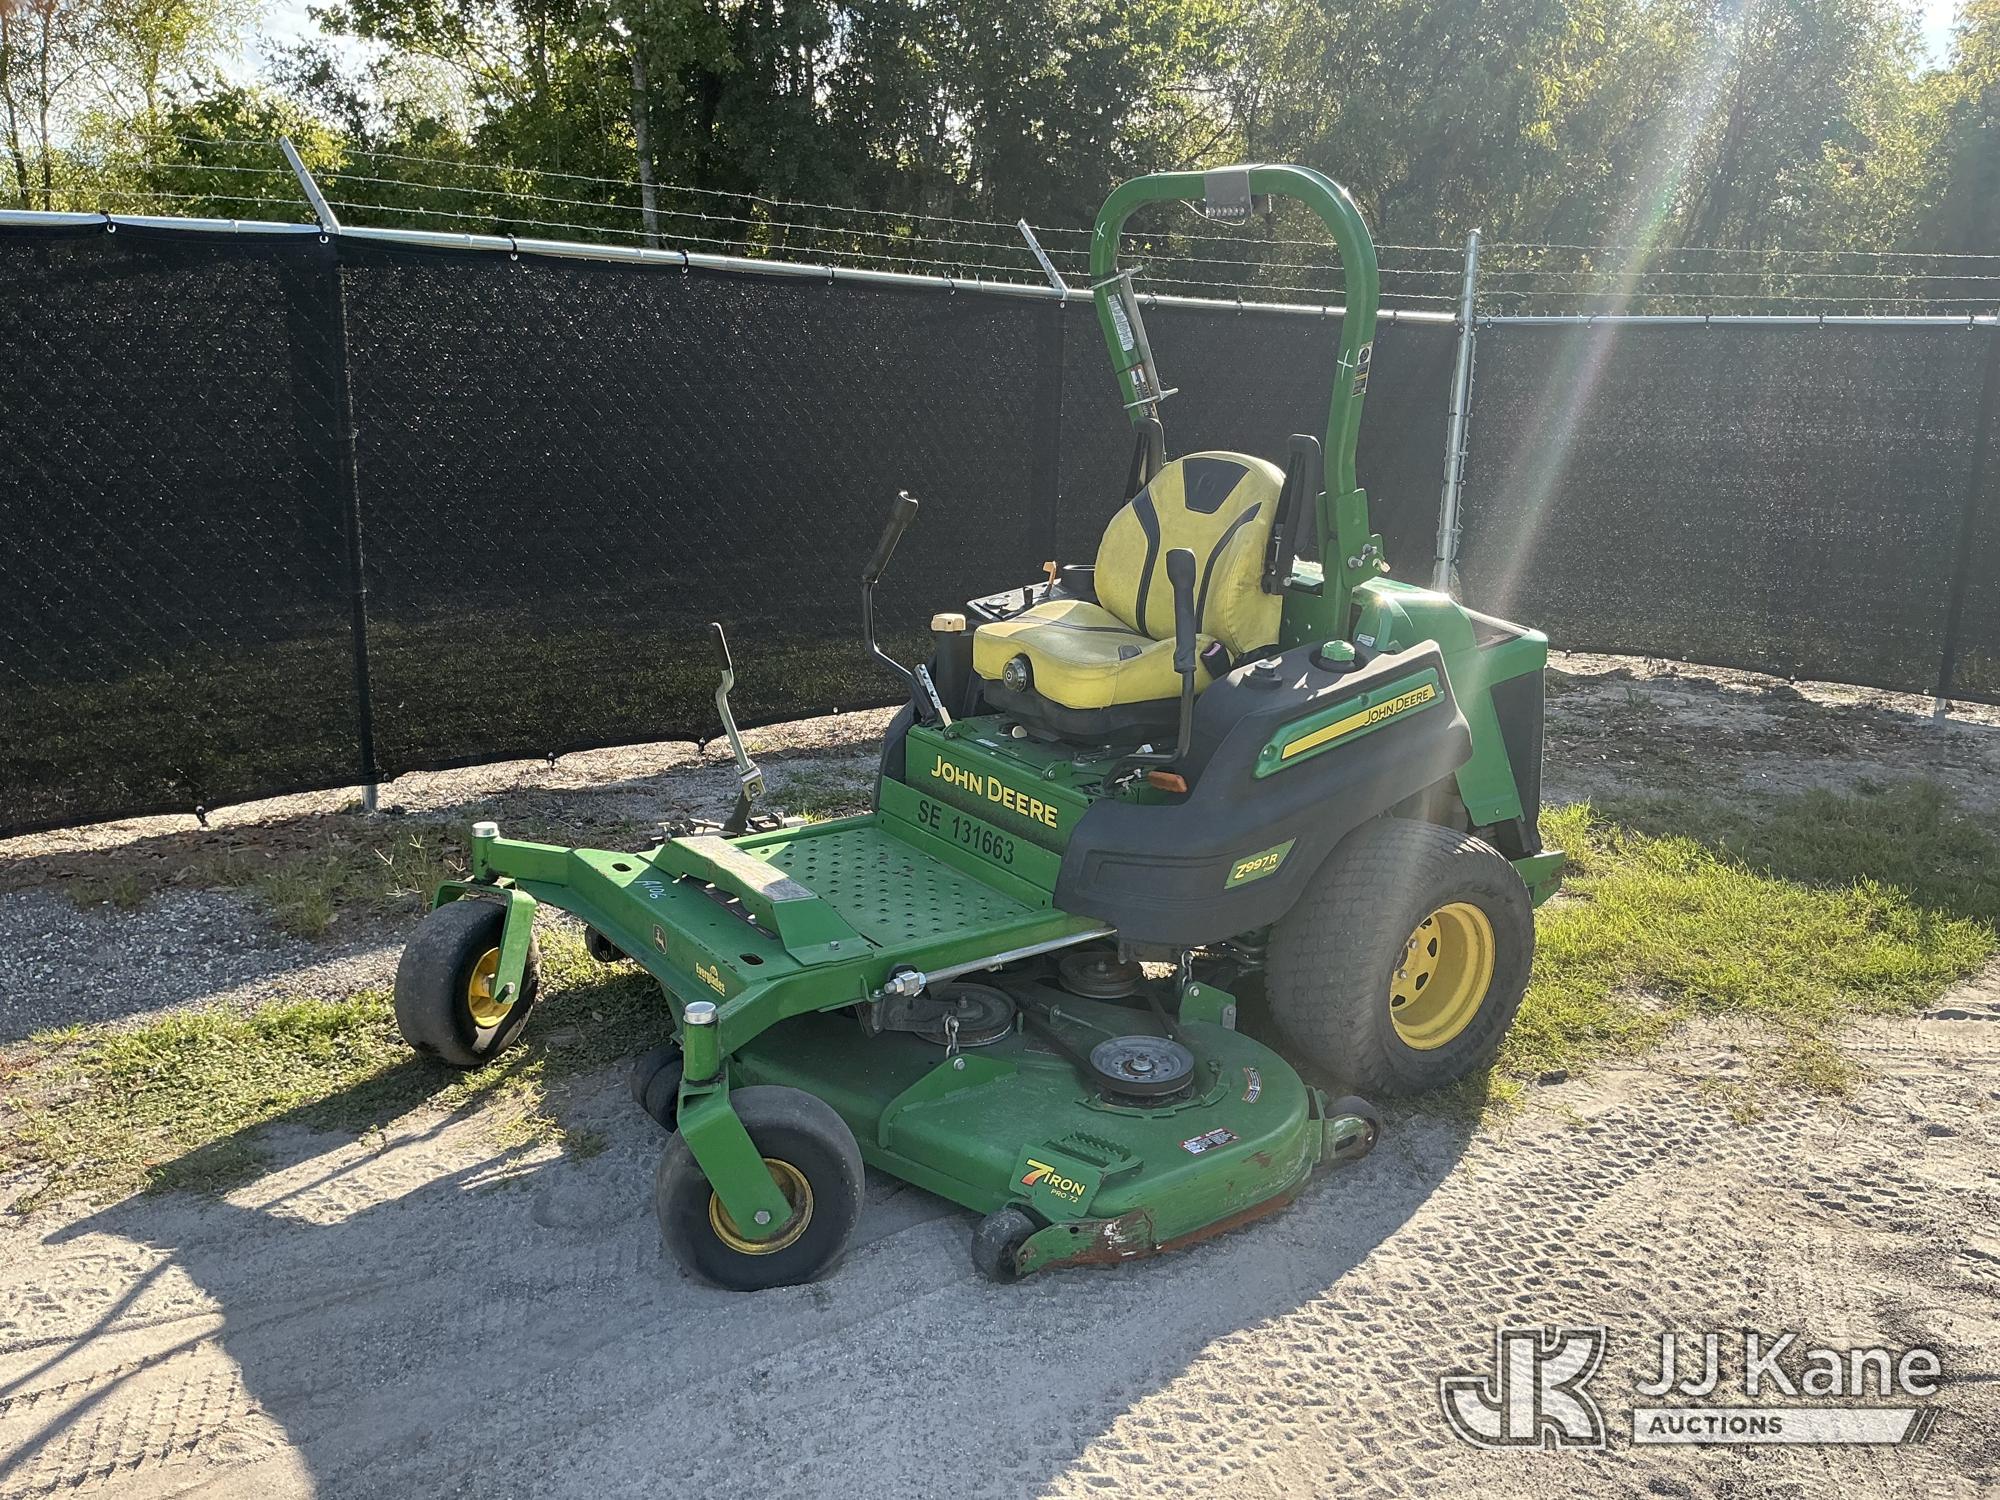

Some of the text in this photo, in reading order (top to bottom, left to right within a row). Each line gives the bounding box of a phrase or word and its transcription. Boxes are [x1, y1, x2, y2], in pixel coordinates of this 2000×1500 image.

[1364, 688, 1429, 725] JOHN DEERE
[930, 755, 1058, 829] JOHN DEERE
[918, 800, 1015, 865] SE 131663
[1234, 853, 1279, 879] Z997R
[1050, 1188, 1067, 1199] PRO
